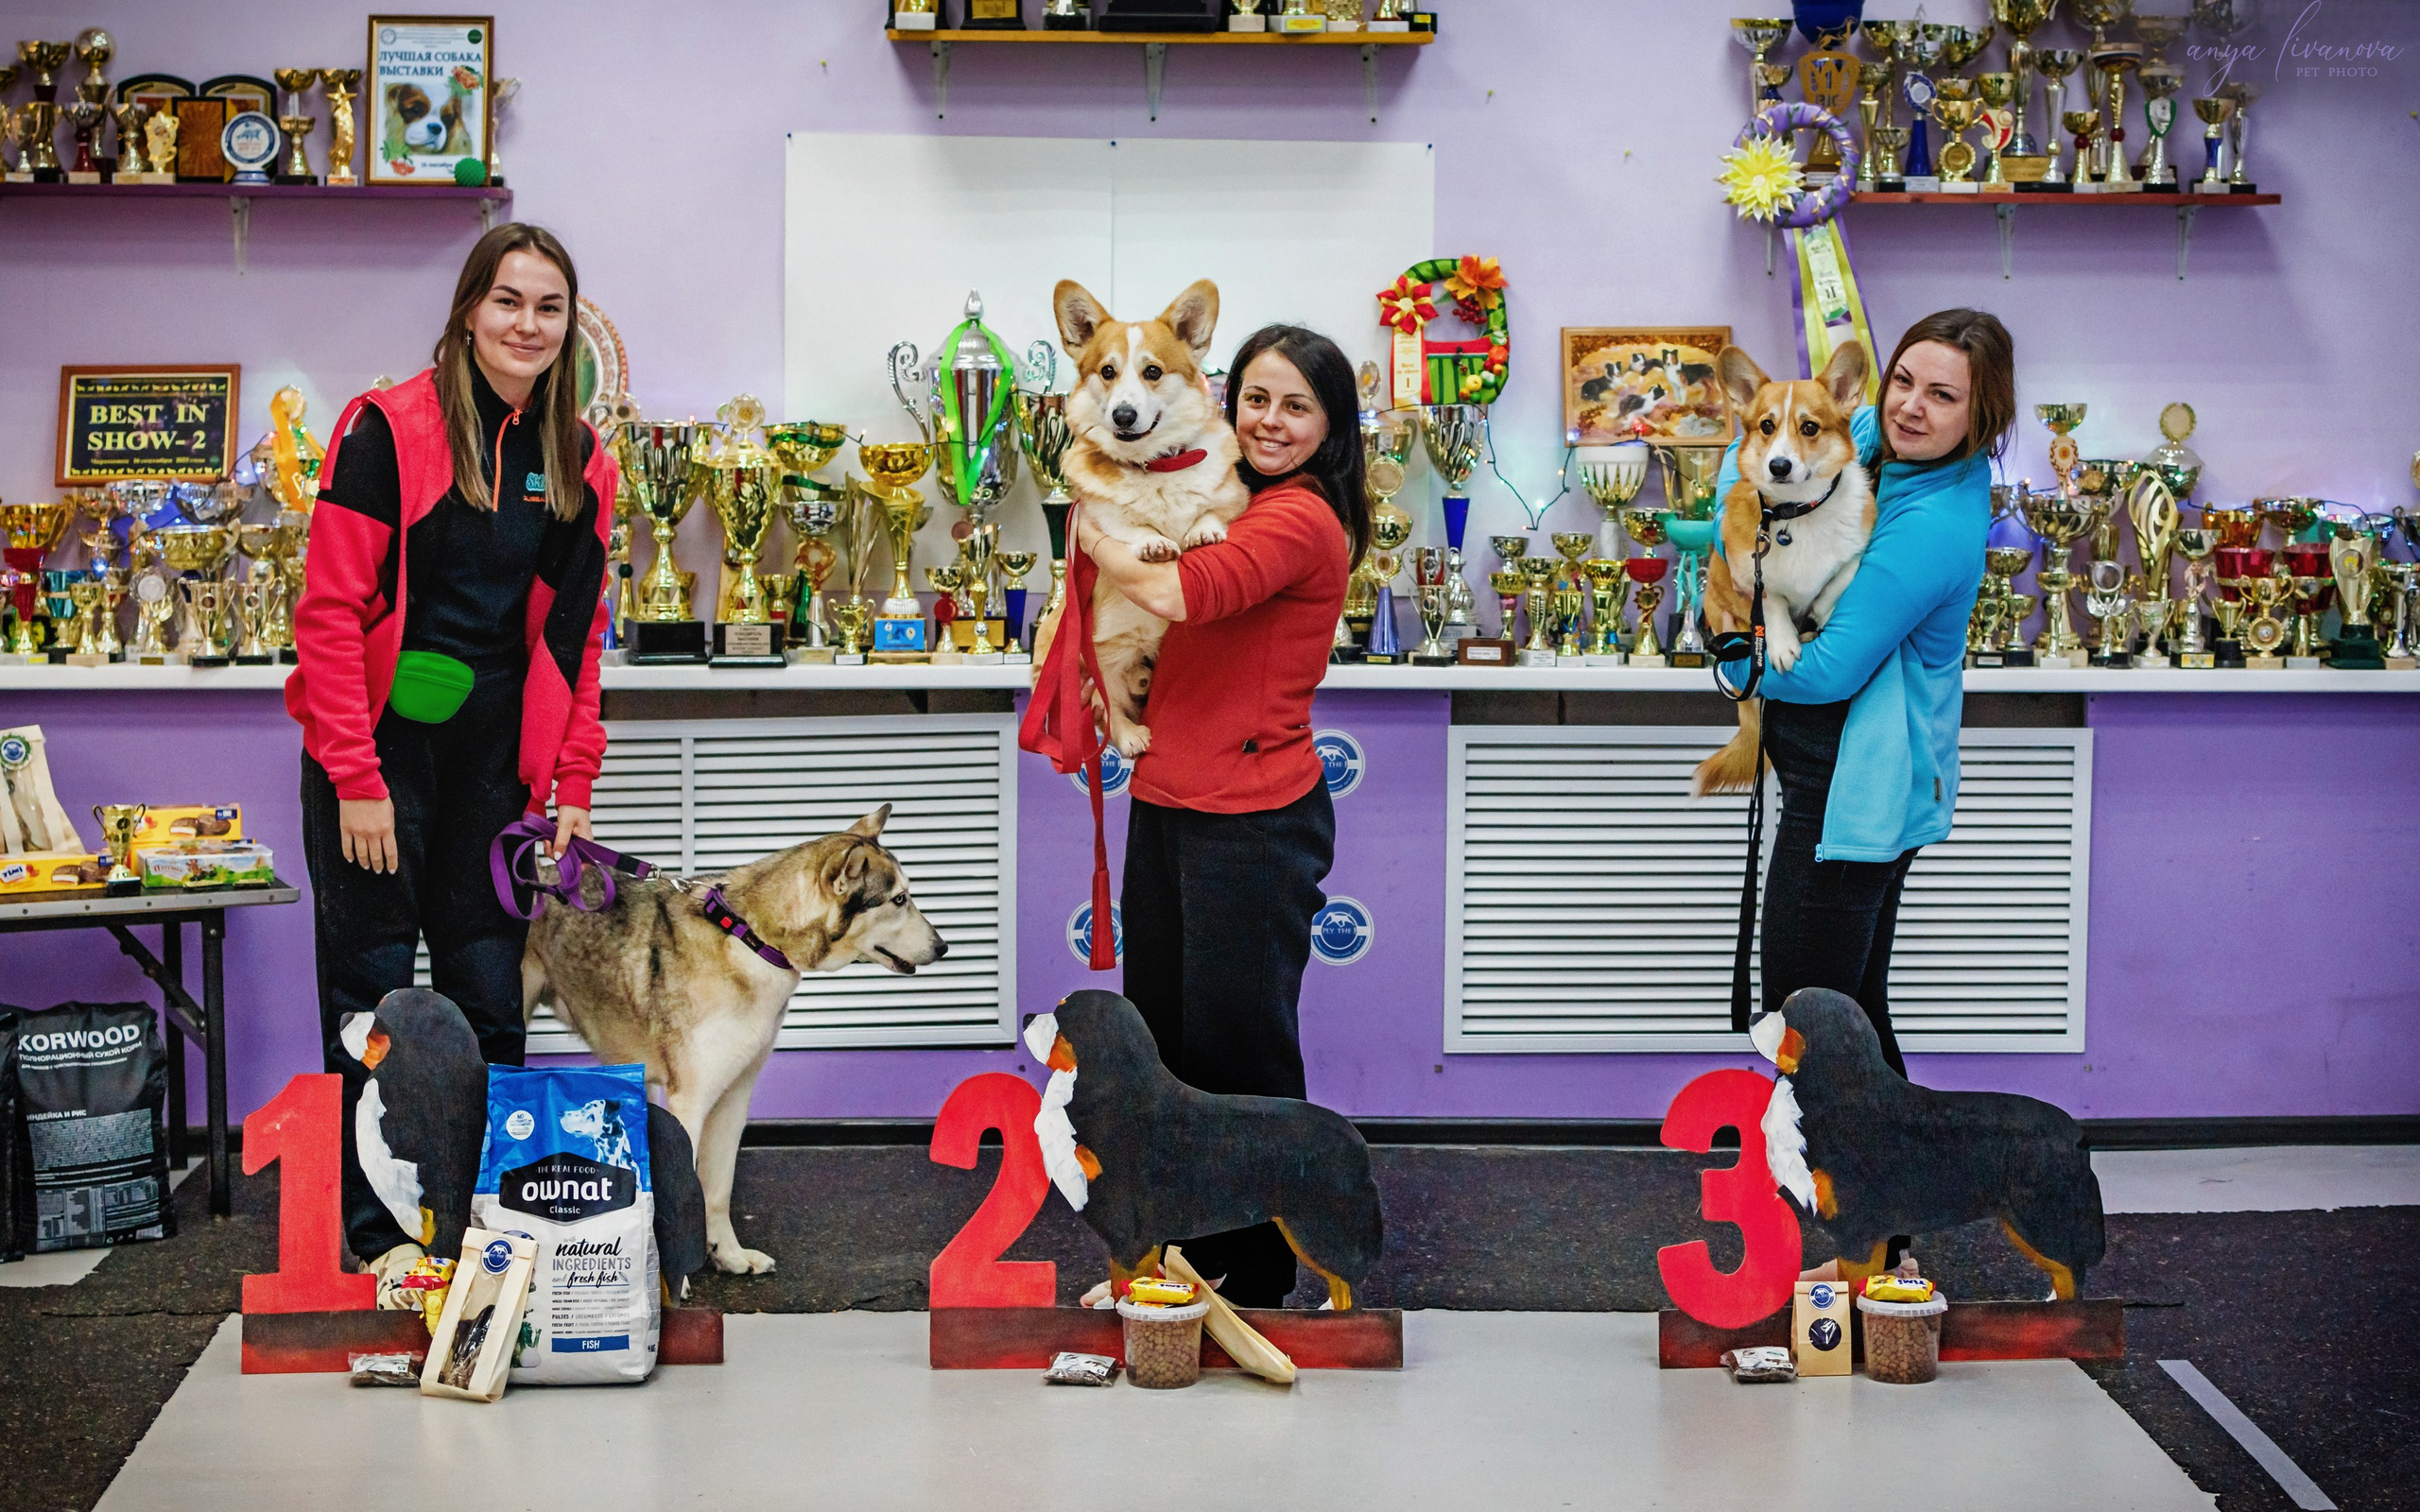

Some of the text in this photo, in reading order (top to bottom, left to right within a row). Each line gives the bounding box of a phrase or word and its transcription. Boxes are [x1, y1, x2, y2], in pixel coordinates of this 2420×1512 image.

[378, 51, 482, 64] ЛУЧШАЯ СОБАКА
[379, 65, 443, 76] ВЫСТАВКИ
[89, 403, 210, 424] BEST IN
[87, 429, 206, 451] SHOW- 2
[17, 1024, 140, 1052] KORWOOD
[95, 1047, 120, 1058] СУХОЙ
[121, 1040, 142, 1054] КОРМ
[26, 1110, 62, 1122] ИНДЕЙКА
[551, 1164, 571, 1173] REAL
[574, 1166, 596, 1175] FOOD
[242, 1073, 377, 1314] 1
[522, 1177, 613, 1202] ownat
[929, 1073, 1057, 1309] 2
[1658, 1069, 1802, 1329] 3
[549, 1206, 580, 1214] Classic
[555, 1236, 623, 1257] natural
[552, 1257, 631, 1271] INGREDIENTS
[552, 1271, 619, 1288] and fresh fish
[581, 1340, 600, 1349] FISH
